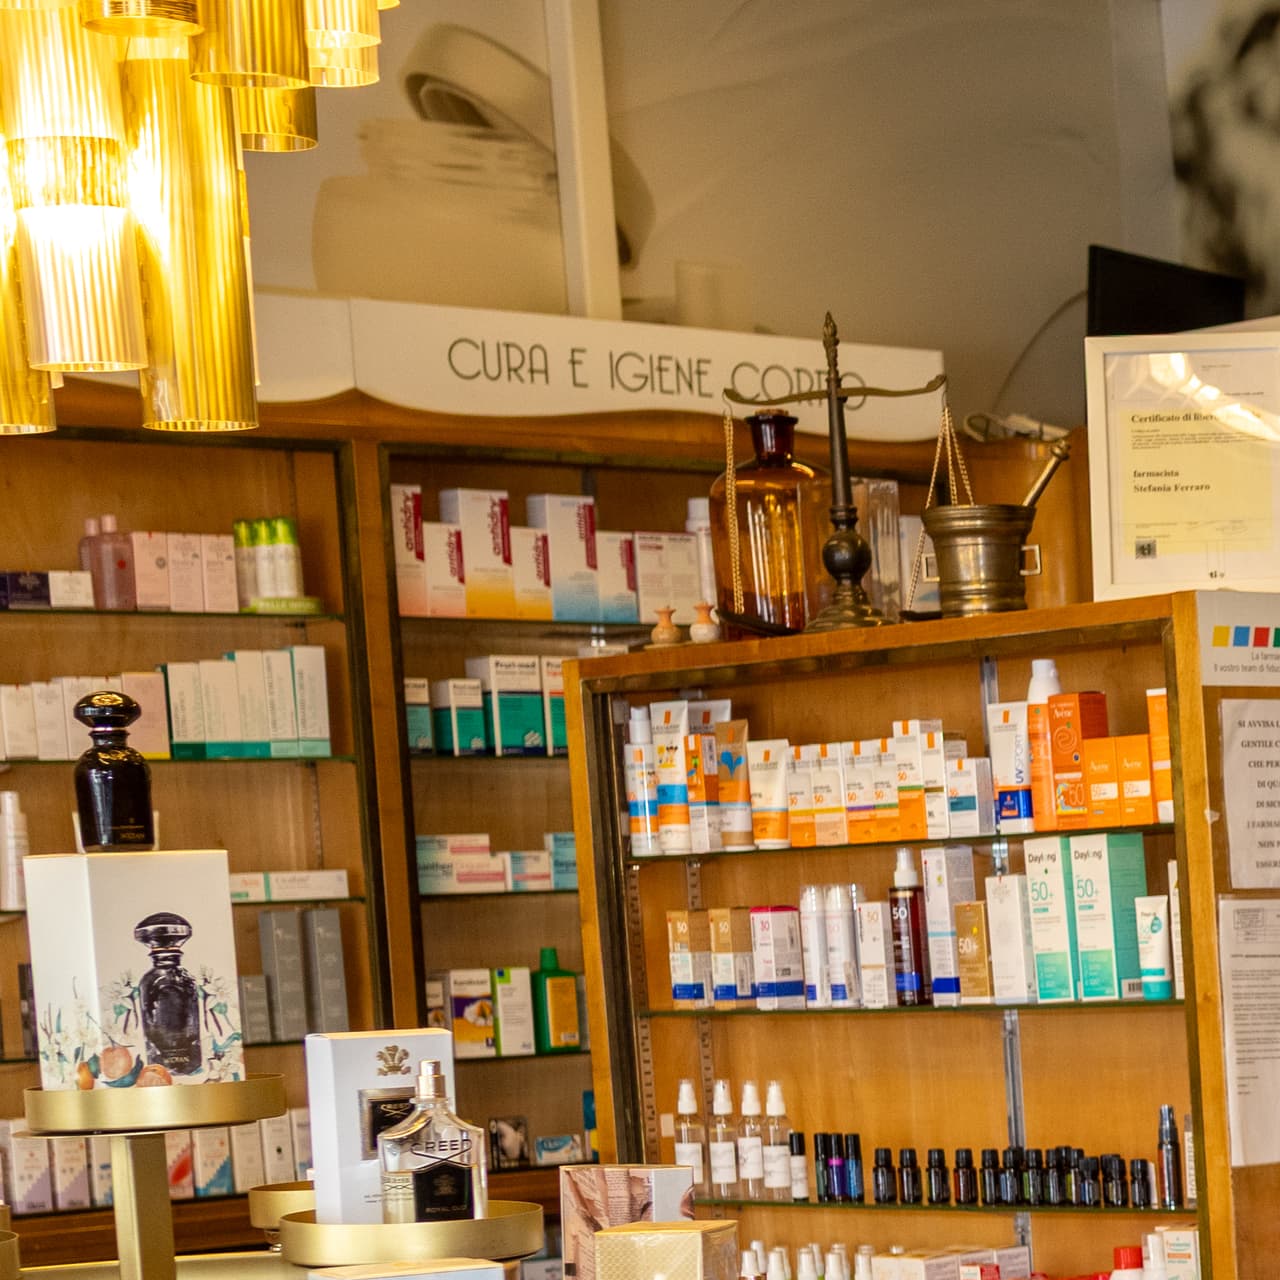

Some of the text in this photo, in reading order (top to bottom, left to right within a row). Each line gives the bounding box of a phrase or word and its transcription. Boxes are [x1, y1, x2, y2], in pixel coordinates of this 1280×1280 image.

[448, 338, 549, 385] CURA
[569, 348, 589, 388] E
[609, 351, 714, 399] IGIENE
[1131, 413, 1180, 424] Certificato
[1134, 483, 1210, 493] Stefania Ferraro
[892, 907, 907, 920] 50
[411, 1139, 472, 1153] CREED
